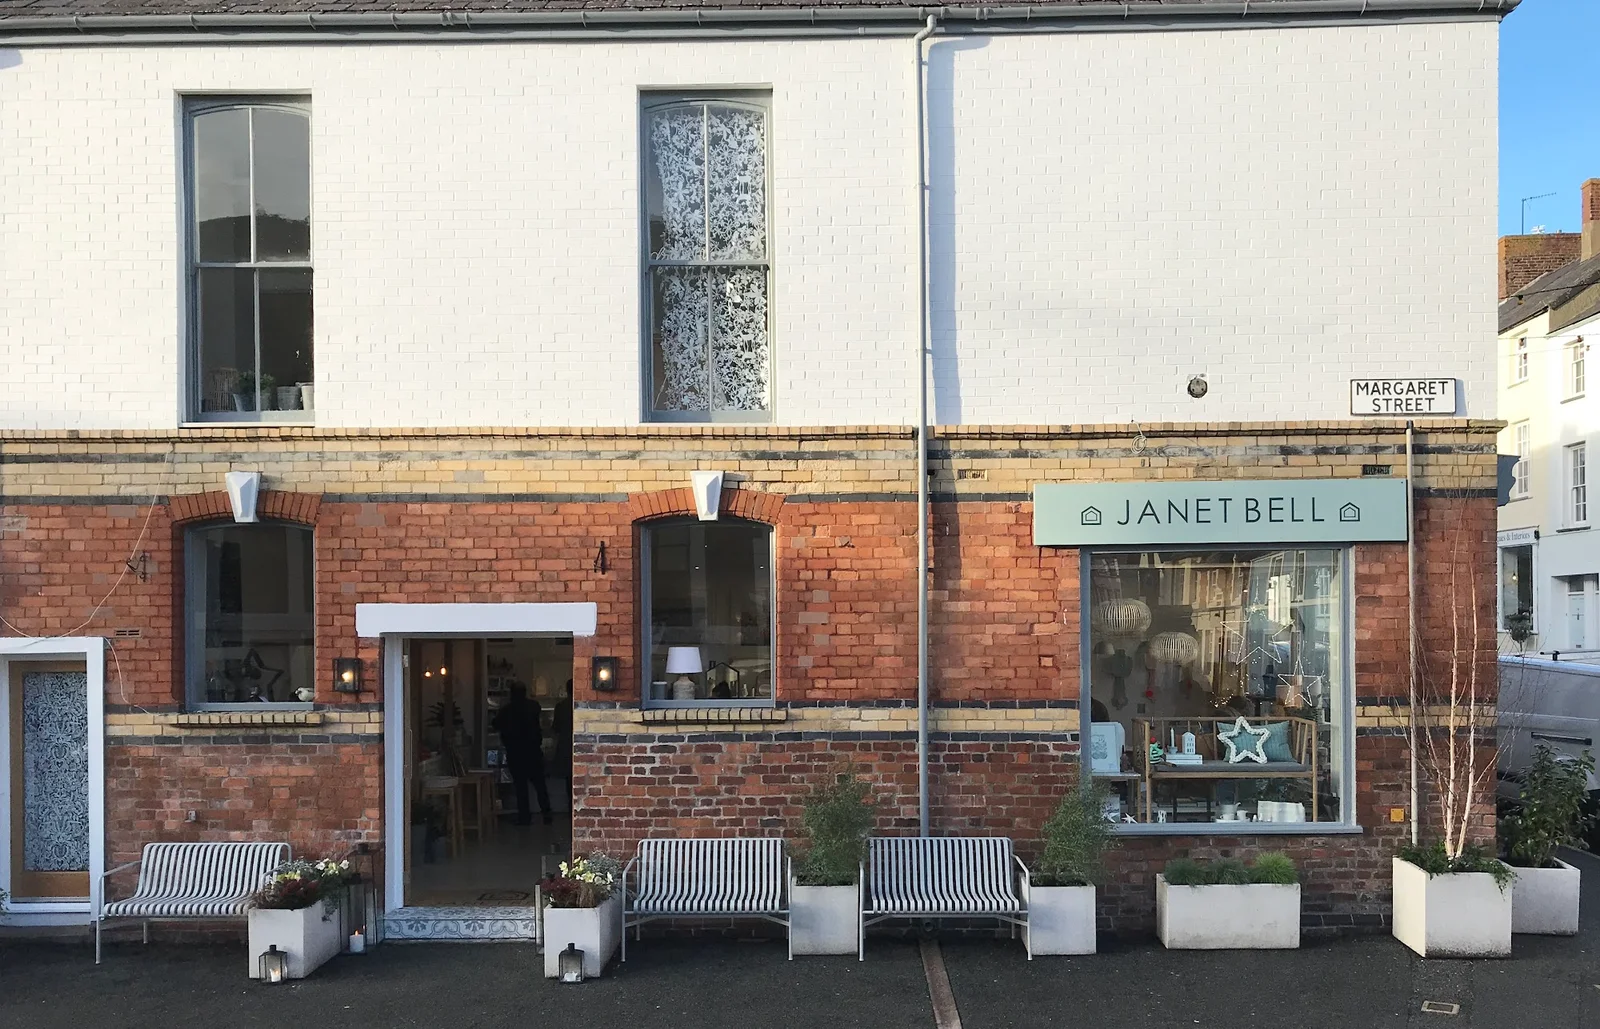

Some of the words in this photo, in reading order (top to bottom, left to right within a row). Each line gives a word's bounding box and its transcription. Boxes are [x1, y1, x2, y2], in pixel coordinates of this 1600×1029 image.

[1356, 381, 1448, 395] MARGARET
[1372, 398, 1435, 412] STREET
[1117, 498, 1232, 526] JANET
[1245, 497, 1325, 523] BELL
